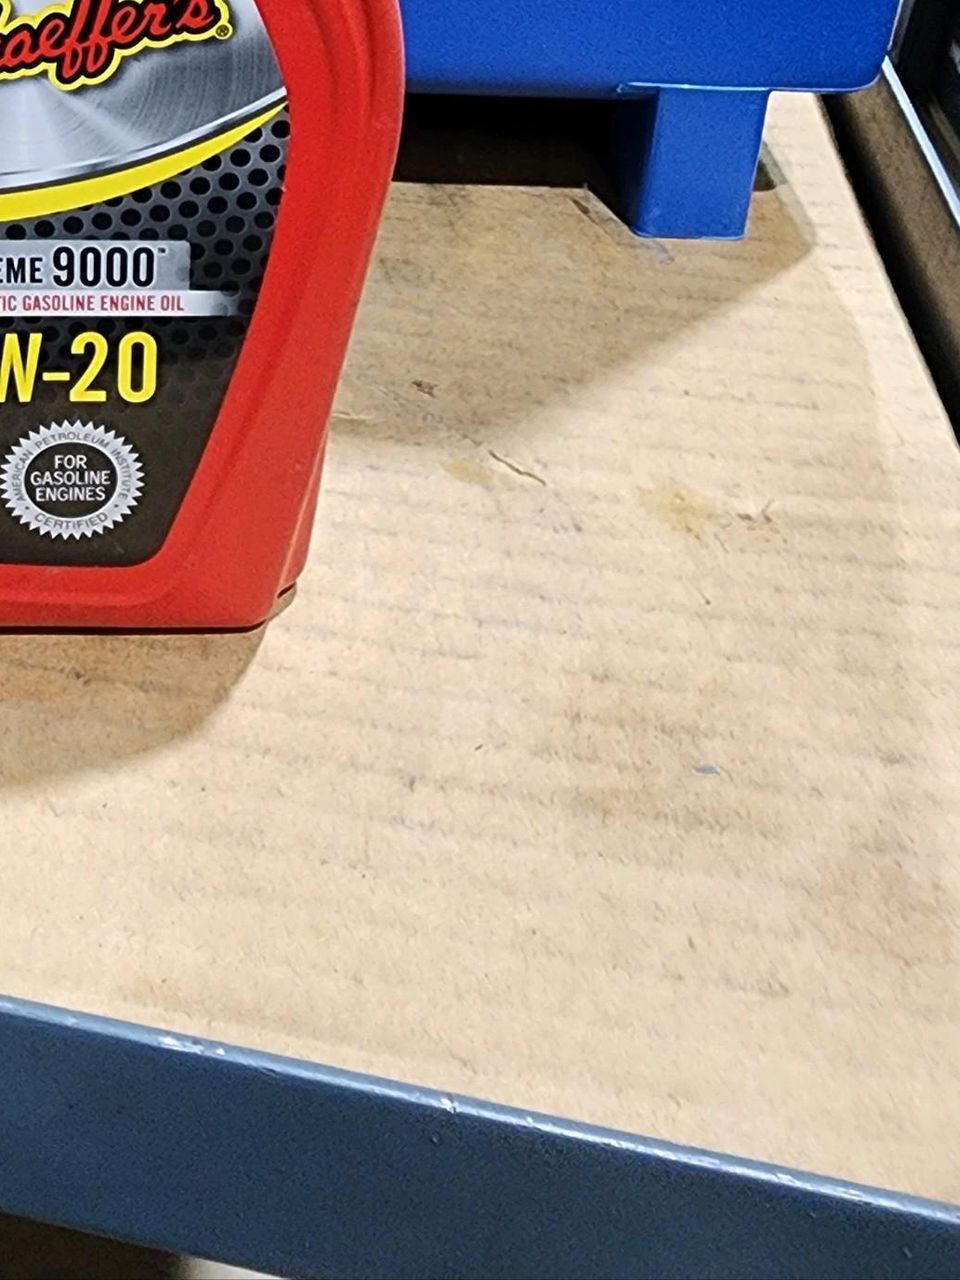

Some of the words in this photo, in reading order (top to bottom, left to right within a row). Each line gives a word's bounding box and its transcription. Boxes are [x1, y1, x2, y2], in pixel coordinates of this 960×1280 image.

[22, 295, 94, 311] GASOLINE
[100, 295, 156, 311] ENGINE
[160, 295, 185, 311] OIL
[11, 449, 34, 503] AMERICAN
[34, 431, 110, 449] PETROLEUM
[110, 448, 132, 501] INSTITUTE
[54, 454, 87, 470] FOR
[30, 470, 111, 486] GASOLINE
[35, 486, 106, 502] ENGINES
[34, 512, 108, 530] CERTIFIED
